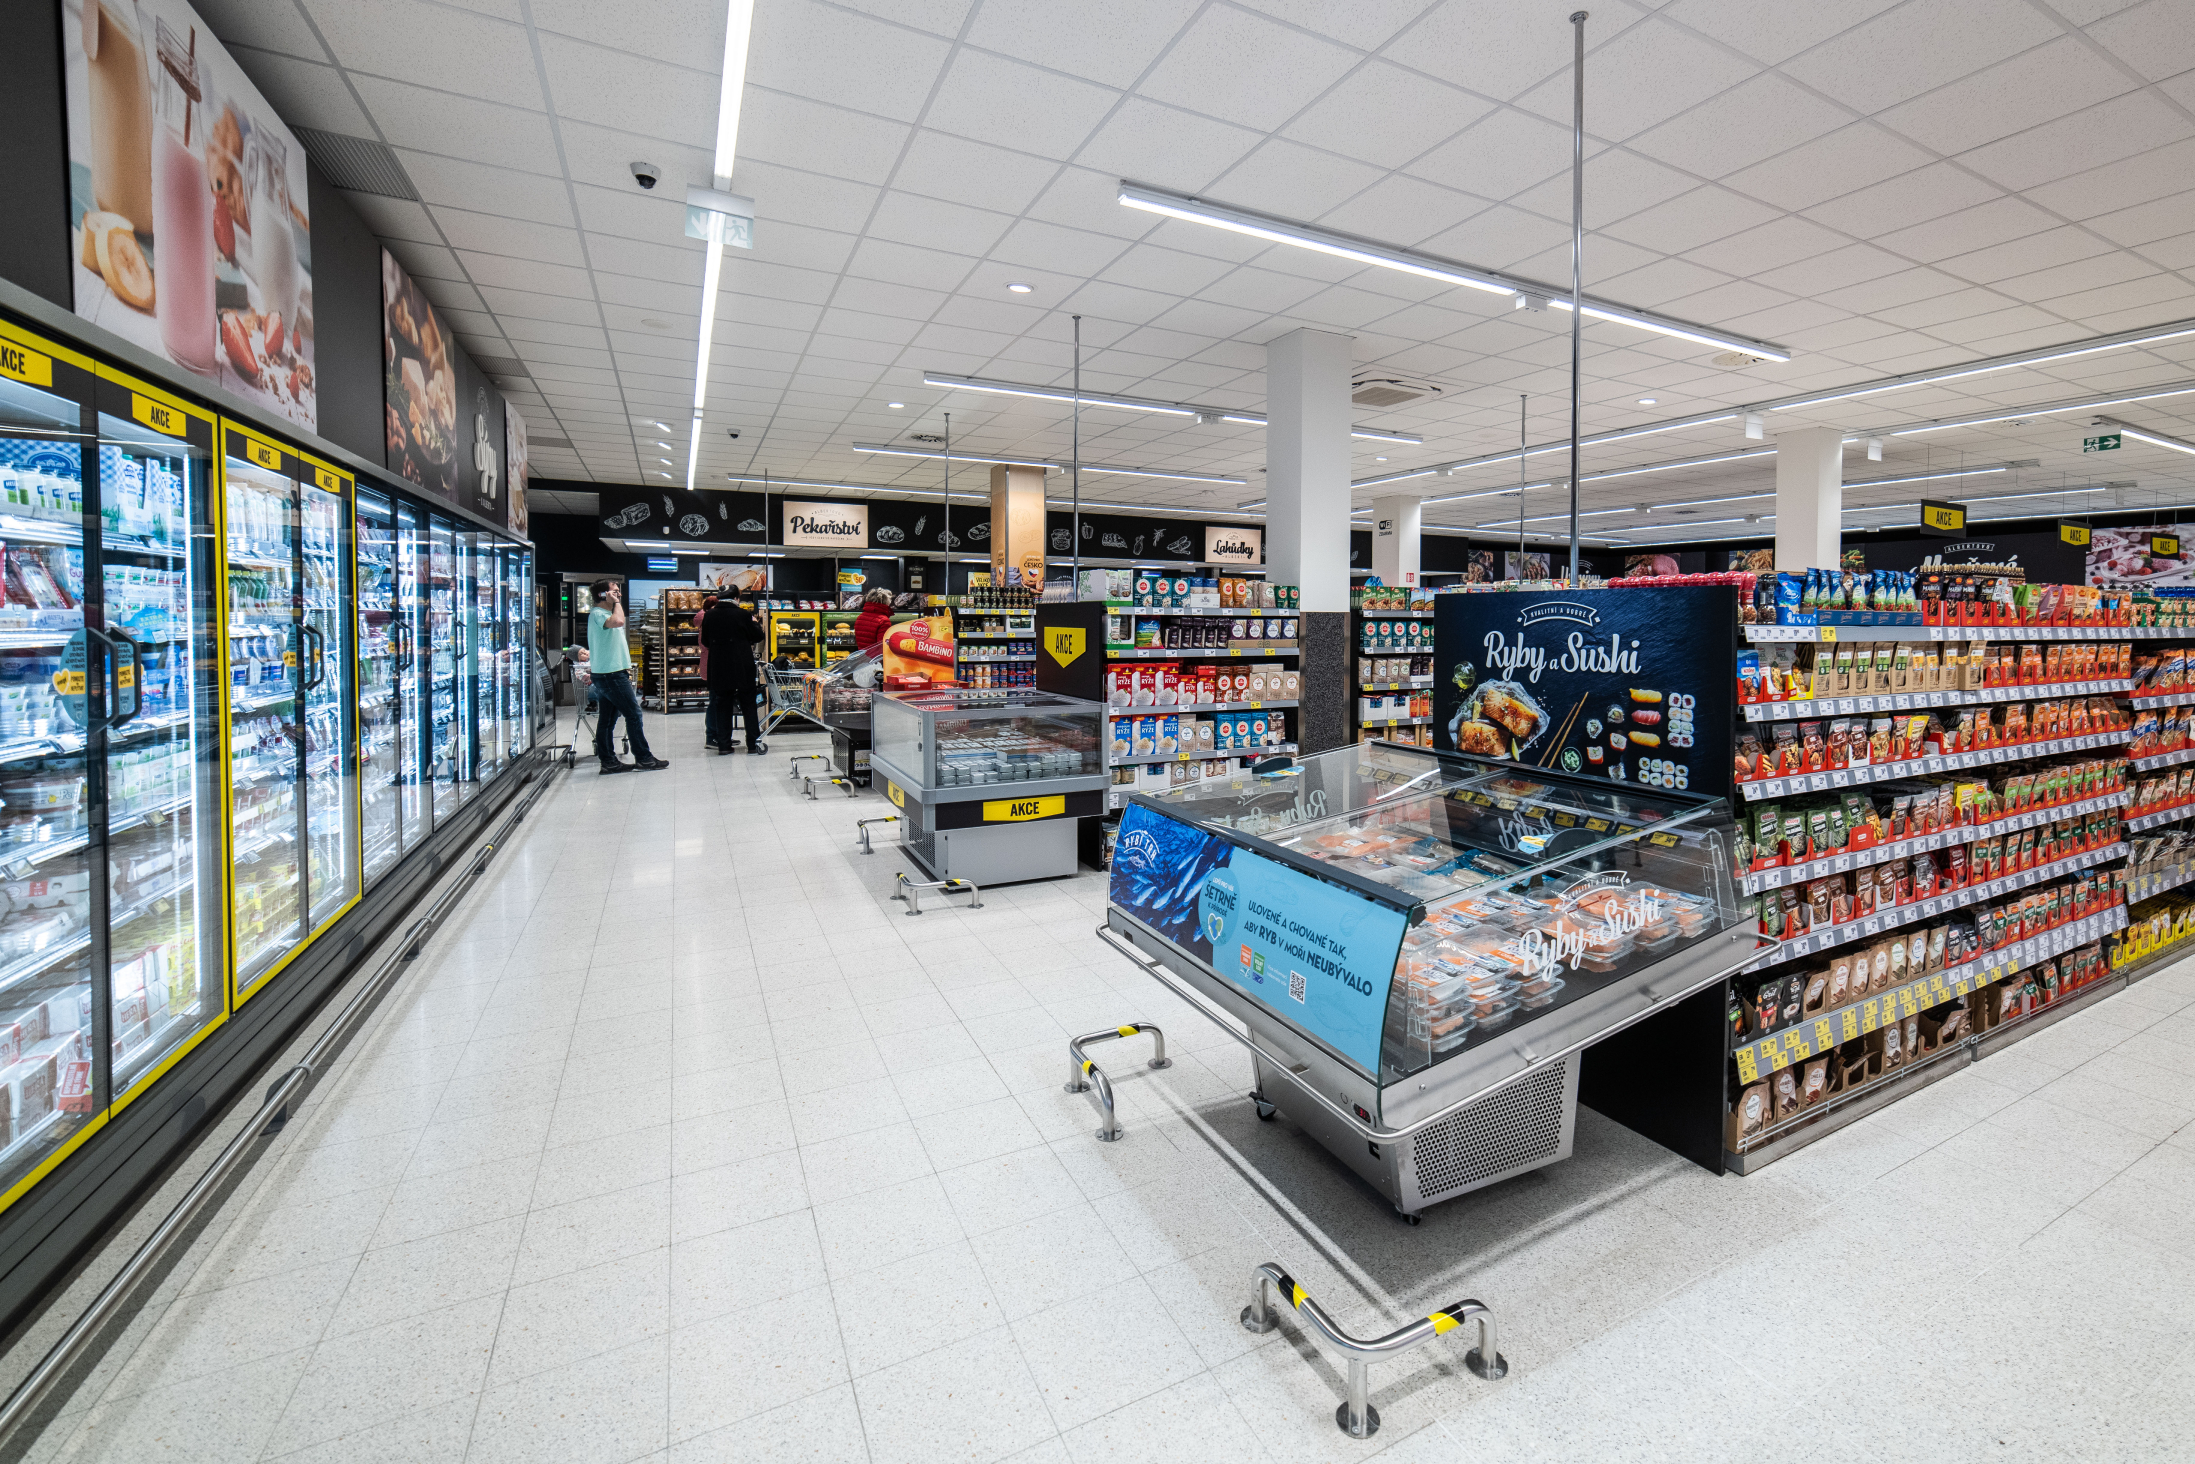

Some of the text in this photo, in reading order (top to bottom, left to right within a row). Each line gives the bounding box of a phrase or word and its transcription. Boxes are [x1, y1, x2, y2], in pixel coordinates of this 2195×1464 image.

[150, 405, 171, 430] AKCE
[257, 446, 272, 466] AKCE
[323, 474, 334, 490] AKCE
[790, 515, 861, 539] Pekařství
[1936, 511, 1952, 527] AKCE
[2069, 529, 2082, 545] AKCE
[2160, 539, 2171, 553] AKCE
[1213, 540, 1254, 559] Lahůdky
[1024, 560, 1044, 569] ČESKO
[1530, 606, 1558, 618] KVALITNÍ
[1566, 607, 1588, 618] DOBRÉ
[910, 624, 929, 634] 100%
[1056, 633, 1073, 655] AKCE
[1484, 630, 1642, 683] Ryby a Sushi
[1010, 802, 1040, 817] AKCE
[1125, 832, 1158, 861] RYBÍ TRH
[1204, 880, 1238, 911] ŠETRNĚ
[1248, 899, 1347, 961] ULOVENÉ A CHOVANÉ TAK,
[1519, 921, 1587, 982] Ryby
[1589, 934, 1598, 948] a
[1600, 890, 1662, 944] Sushi
[1244, 919, 1373, 997] ABY RYB V MOŘI NEUBÝVALO
